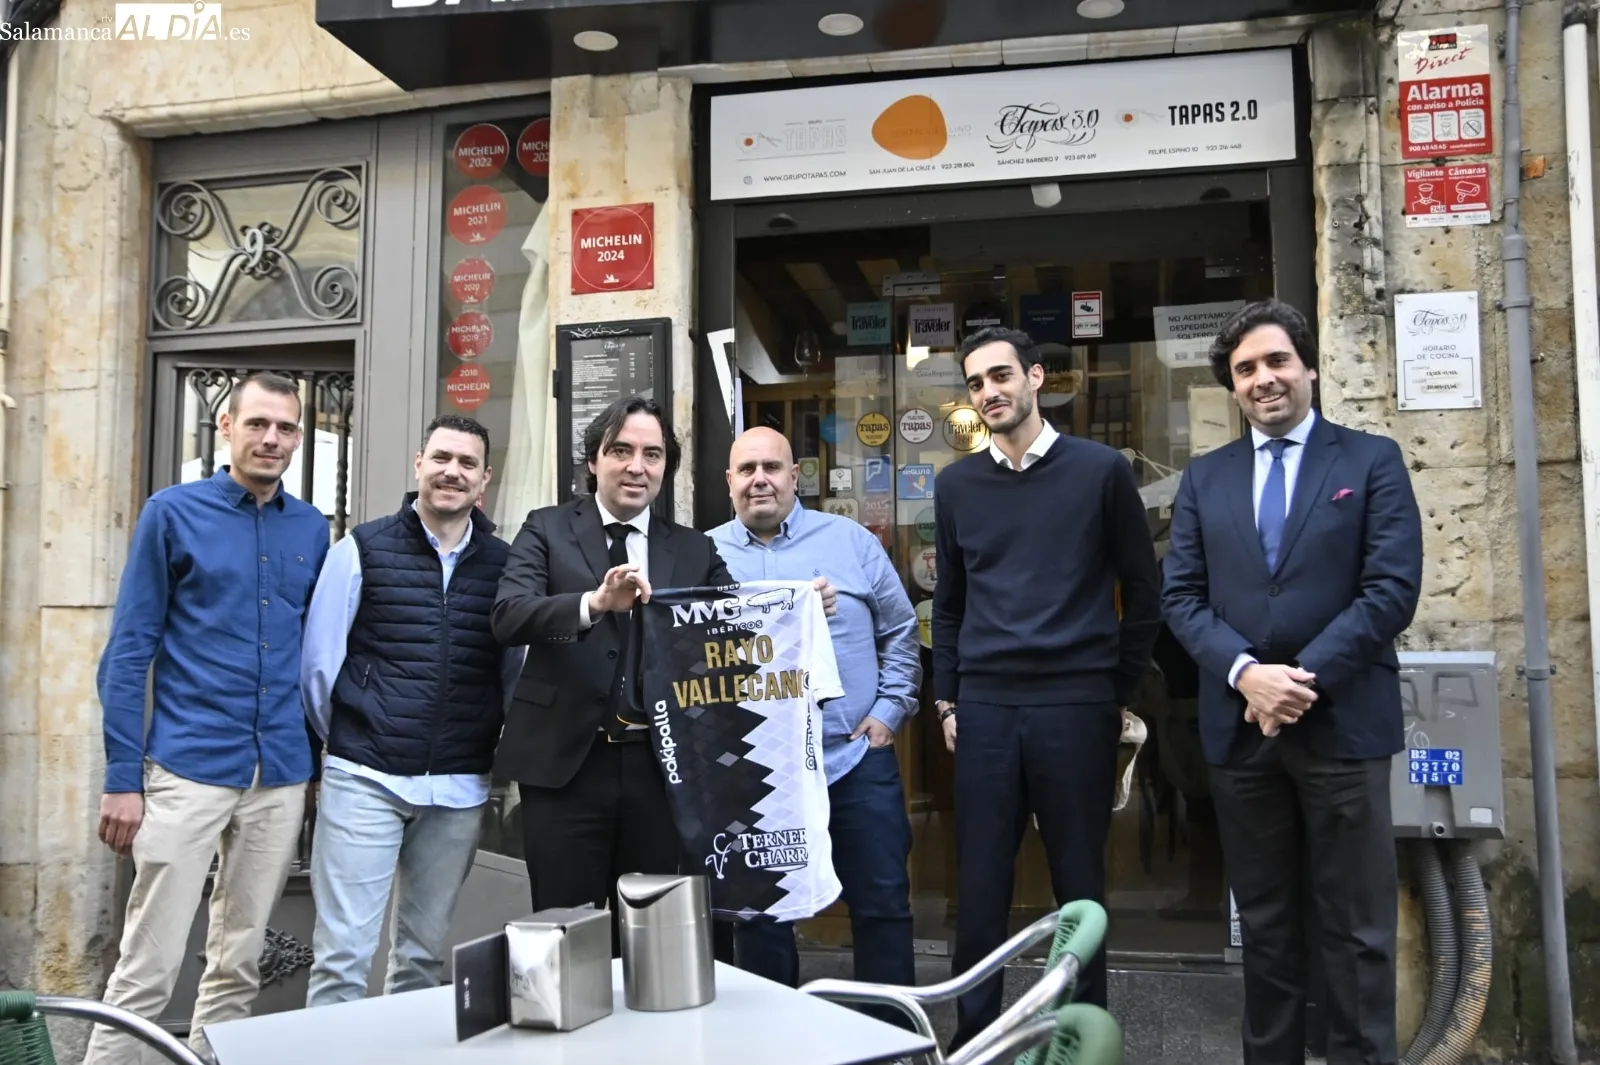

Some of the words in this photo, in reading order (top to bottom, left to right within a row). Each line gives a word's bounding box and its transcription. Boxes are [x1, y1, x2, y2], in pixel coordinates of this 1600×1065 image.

[1414, 47, 1473, 74] Direct
[1407, 82, 1484, 102] Alarma
[1424, 101, 1446, 110] aviso
[1168, 102, 1225, 126] TAPAS
[1230, 99, 1257, 122] 2.0
[995, 102, 1069, 152] Tapas
[1071, 108, 1099, 130] 3.0
[784, 125, 847, 152] TAPAS
[458, 145, 504, 157] MICHELIN
[522, 141, 550, 151] MICH
[468, 157, 493, 168] 2022
[532, 152, 550, 163] 202
[1026, 156, 1053, 164] BARBERO
[763, 170, 847, 183] WWW.GRUPOTAPAS.COM
[1407, 169, 1444, 179] Vigilante
[1448, 167, 1487, 176] Cámaras
[453, 202, 501, 217] MICHELIN
[467, 216, 488, 226] 2021
[580, 234, 642, 249] MICHELIN
[597, 250, 625, 262] 2024
[453, 272, 491, 282] MICHELIN
[451, 324, 490, 333] MICHELIN
[850, 315, 887, 331] Traveler
[912, 317, 951, 334] Traveler
[1169, 321, 1218, 332] DESPEDIDAS
[461, 334, 479, 342] 2019
[1423, 344, 1457, 352] HORARIO
[459, 369, 478, 377] 2018
[447, 382, 490, 392] MICHELIN
[946, 419, 983, 435] Traveler
[670, 597, 741, 628] MMG
[706, 620, 763, 636] IBÉRICOS
[704, 635, 774, 669] RAYO
[654, 700, 682, 785] pakipalla
[1411, 749, 1427, 760] B2
[1445, 750, 1461, 760] 02
[1447, 773, 1457, 784] C
[745, 846, 809, 869] CHARR
